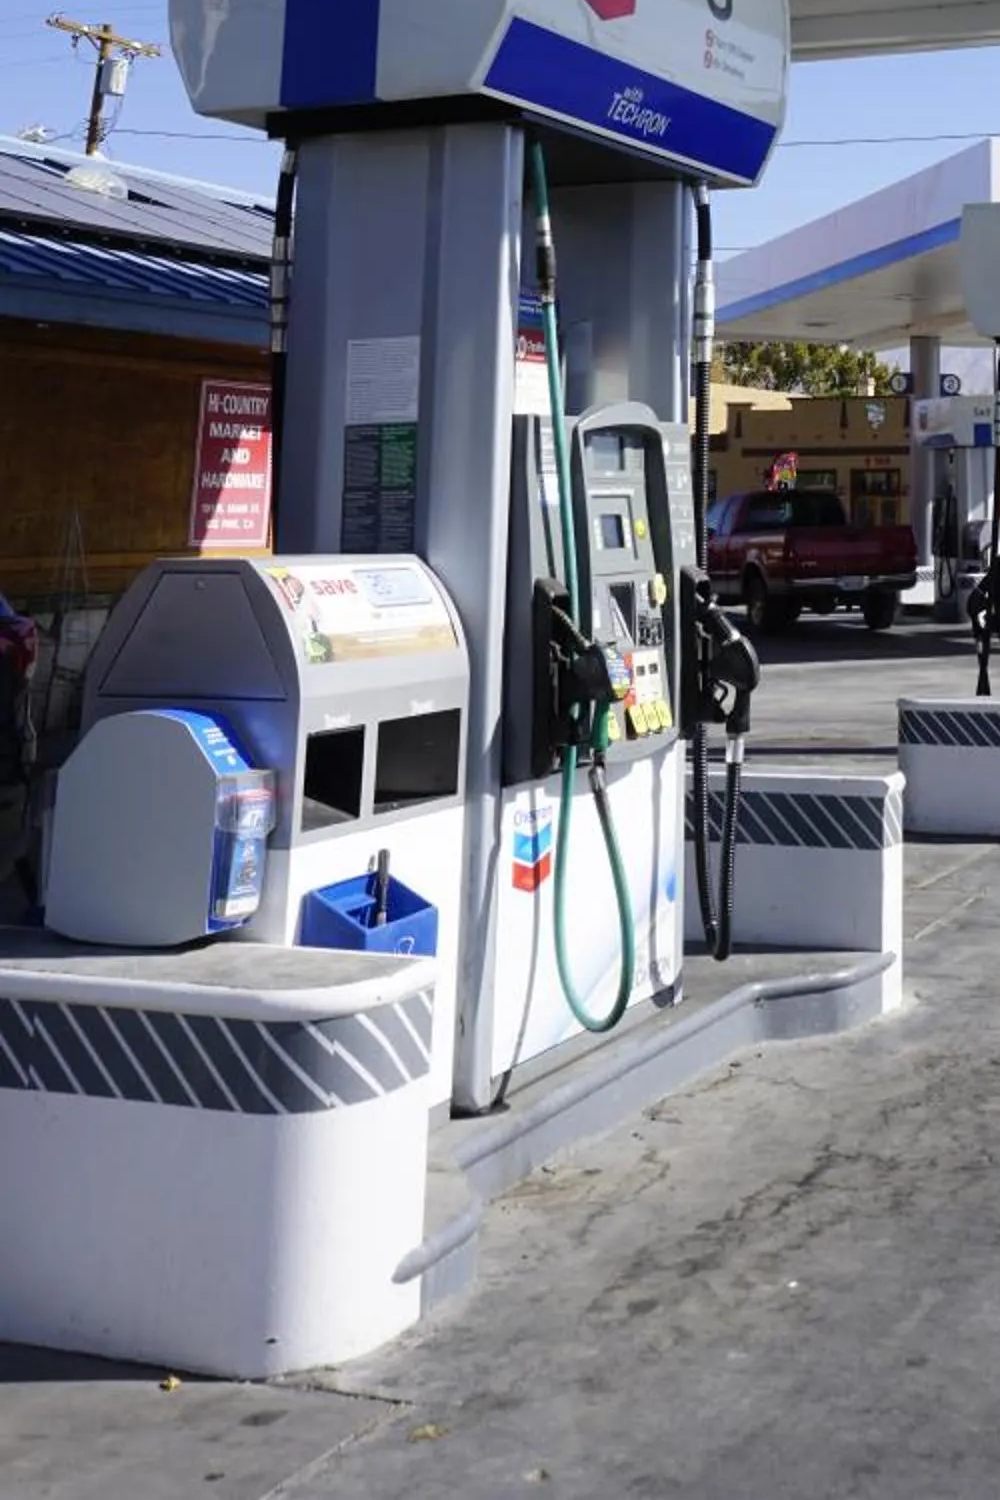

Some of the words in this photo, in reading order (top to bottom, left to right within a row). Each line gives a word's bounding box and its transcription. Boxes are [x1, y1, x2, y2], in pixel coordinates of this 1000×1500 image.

[207, 392, 269, 416] HI-COUNTRY
[209, 421, 264, 441] MARKET
[220, 447, 251, 465] AND
[201, 472, 265, 489] HARDWARE
[310, 578, 358, 596] save
